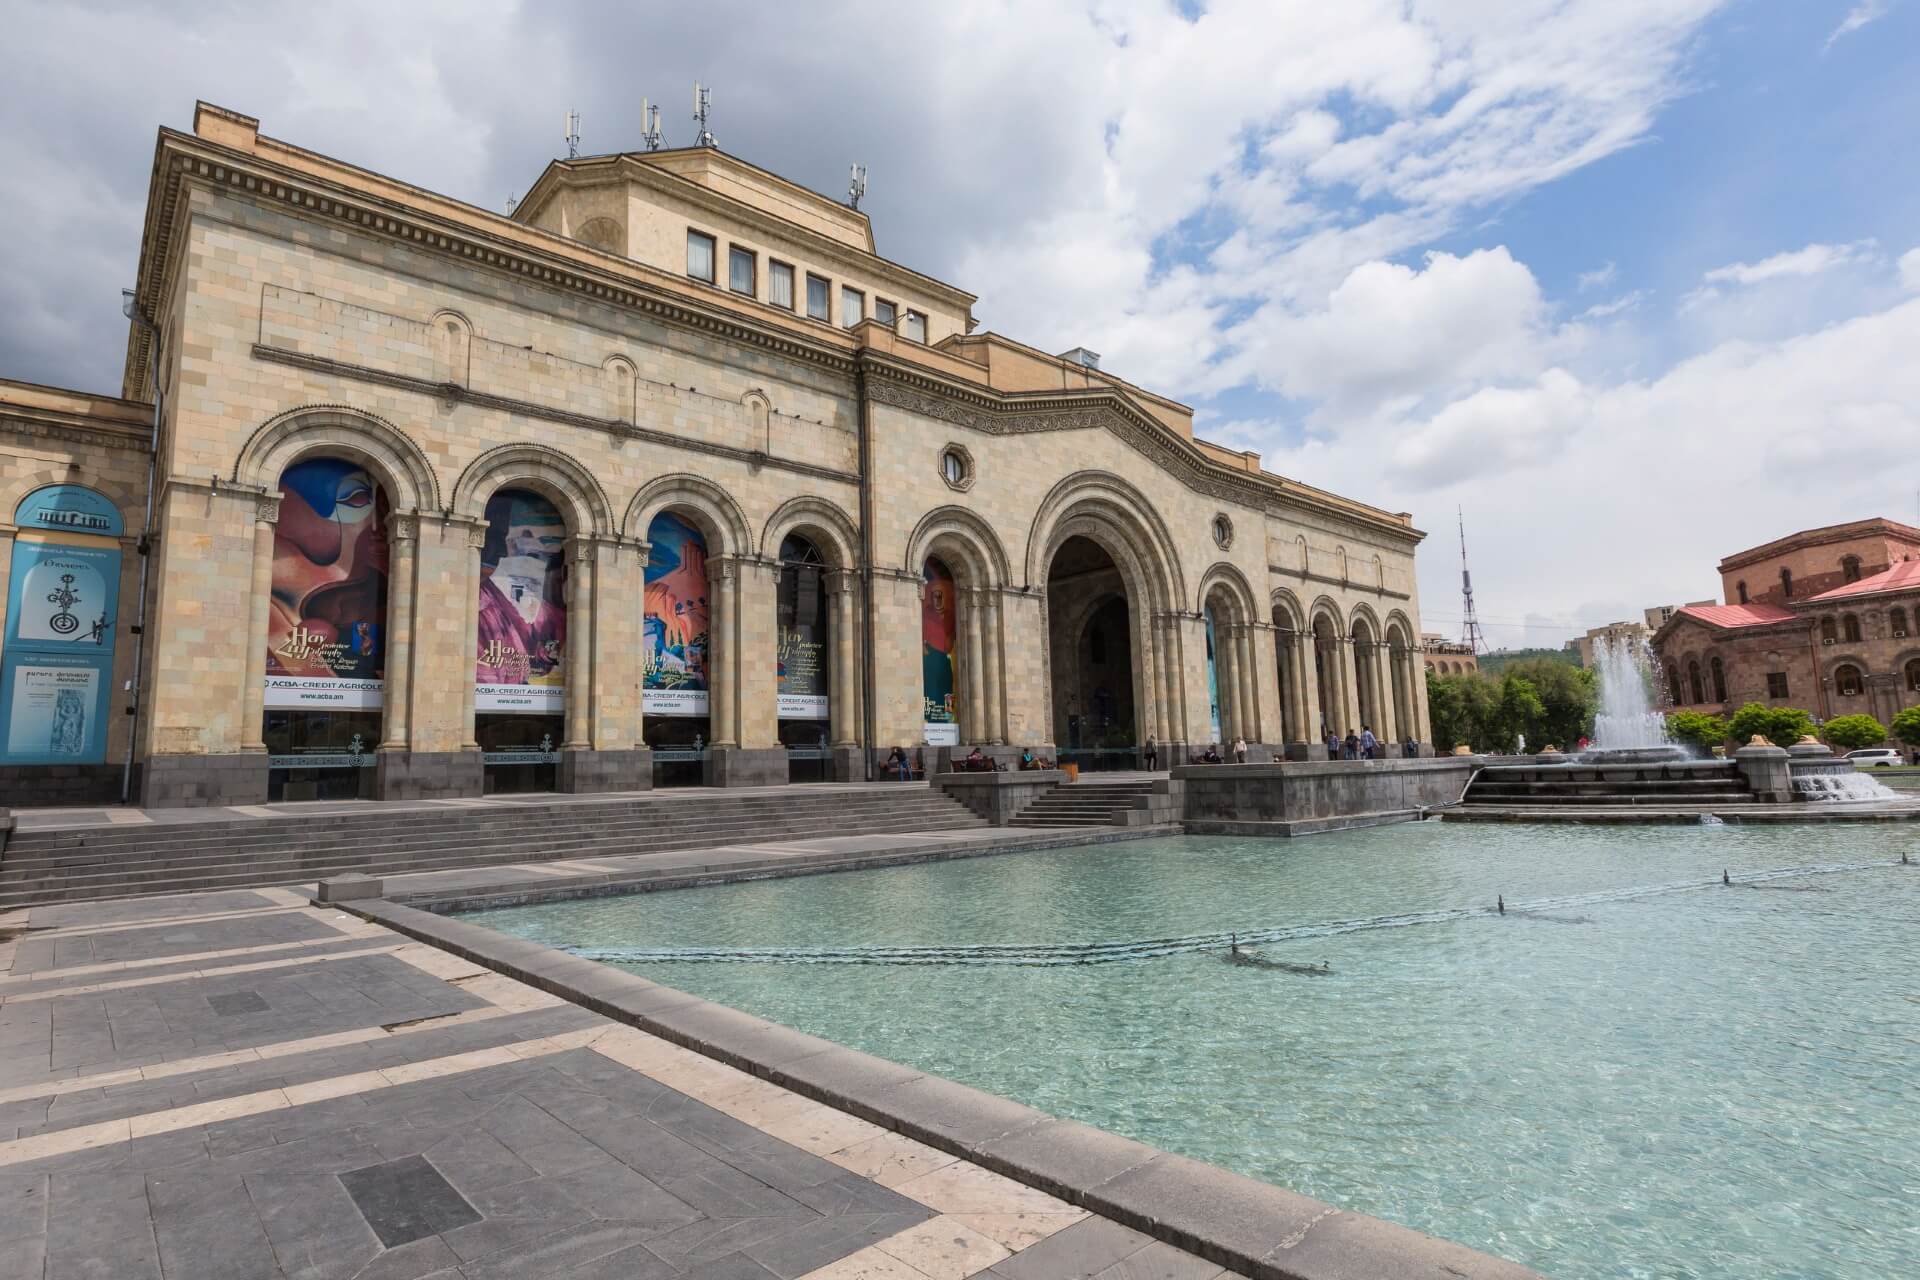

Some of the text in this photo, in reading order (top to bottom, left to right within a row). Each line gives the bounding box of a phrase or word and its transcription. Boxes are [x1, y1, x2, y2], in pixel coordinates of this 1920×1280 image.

[292, 626, 328, 647] Hay
[489, 639, 516, 657] Hay
[475, 687, 526, 695] ACBA-CREDIT
